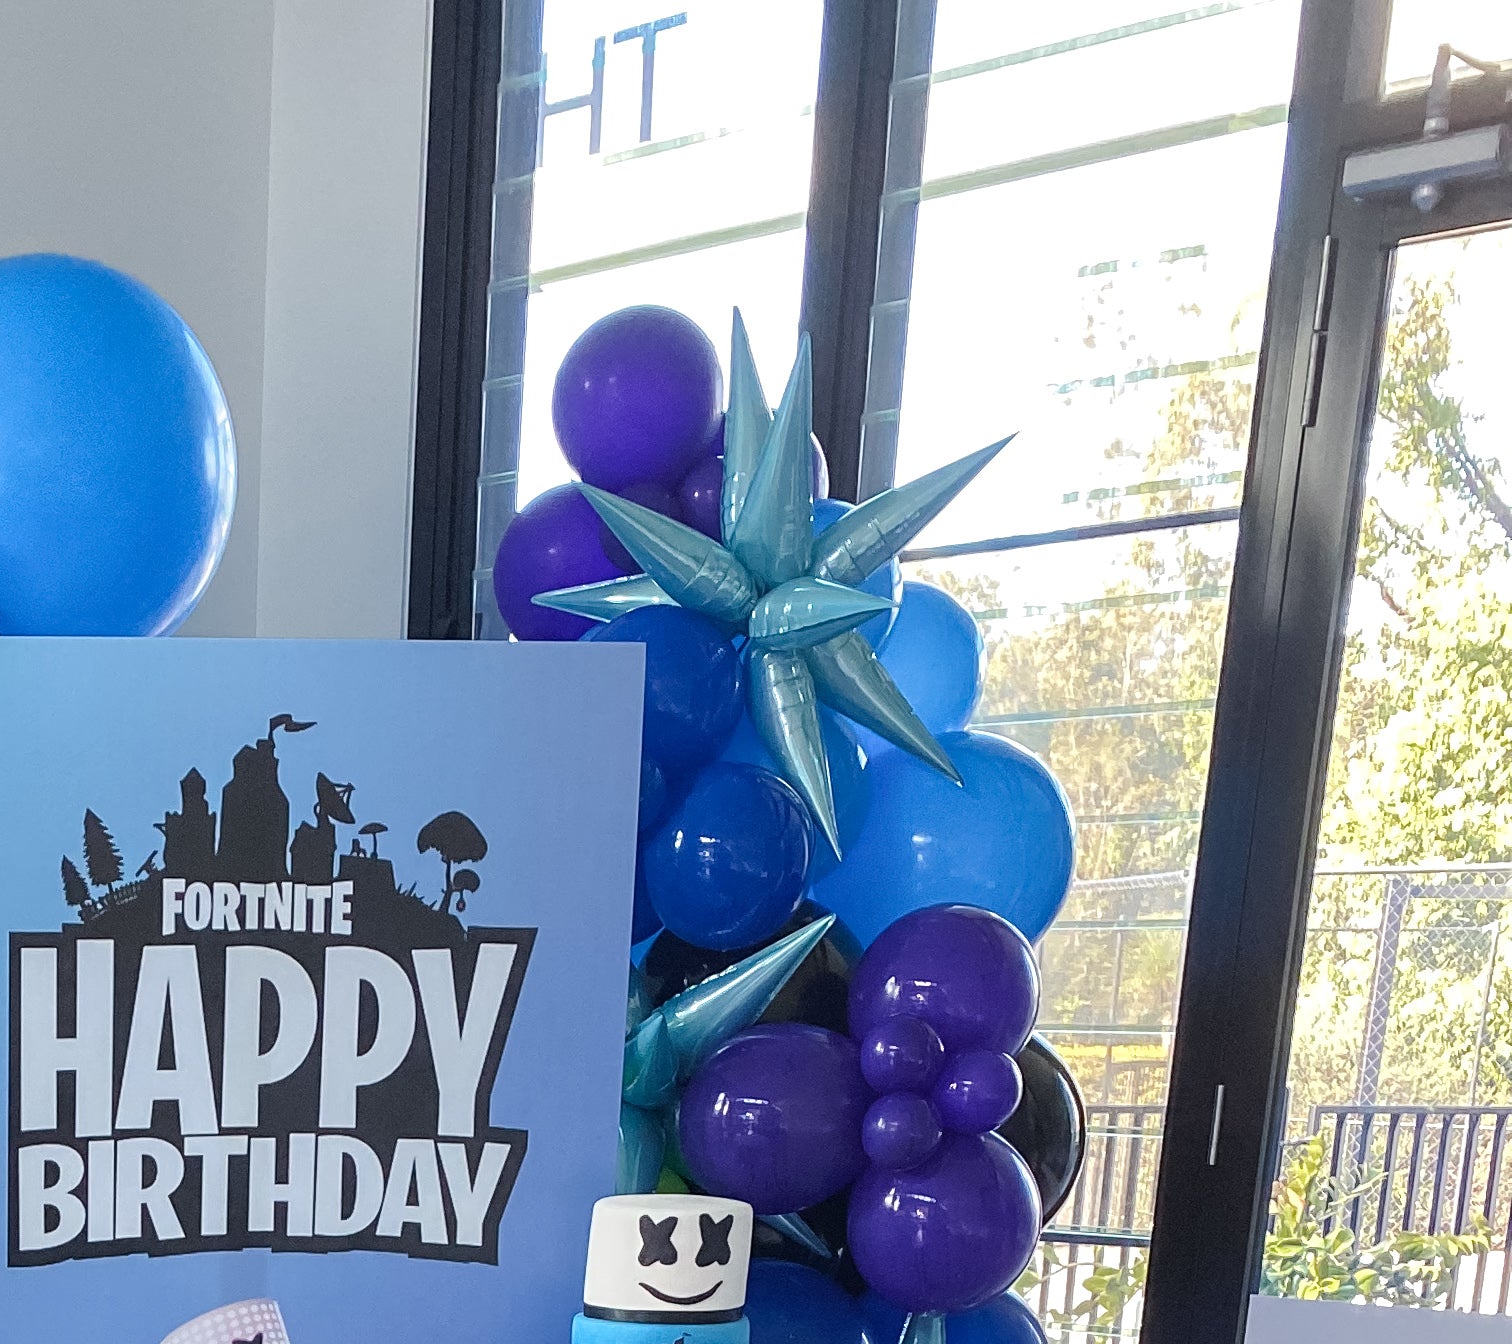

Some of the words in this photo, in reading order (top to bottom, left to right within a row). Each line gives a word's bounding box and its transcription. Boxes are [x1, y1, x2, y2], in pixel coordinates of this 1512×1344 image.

[161, 877, 354, 936] FORTNITE
[20, 938, 518, 1139] HAPPY
[17, 1132, 512, 1252] BIRTHDAY
